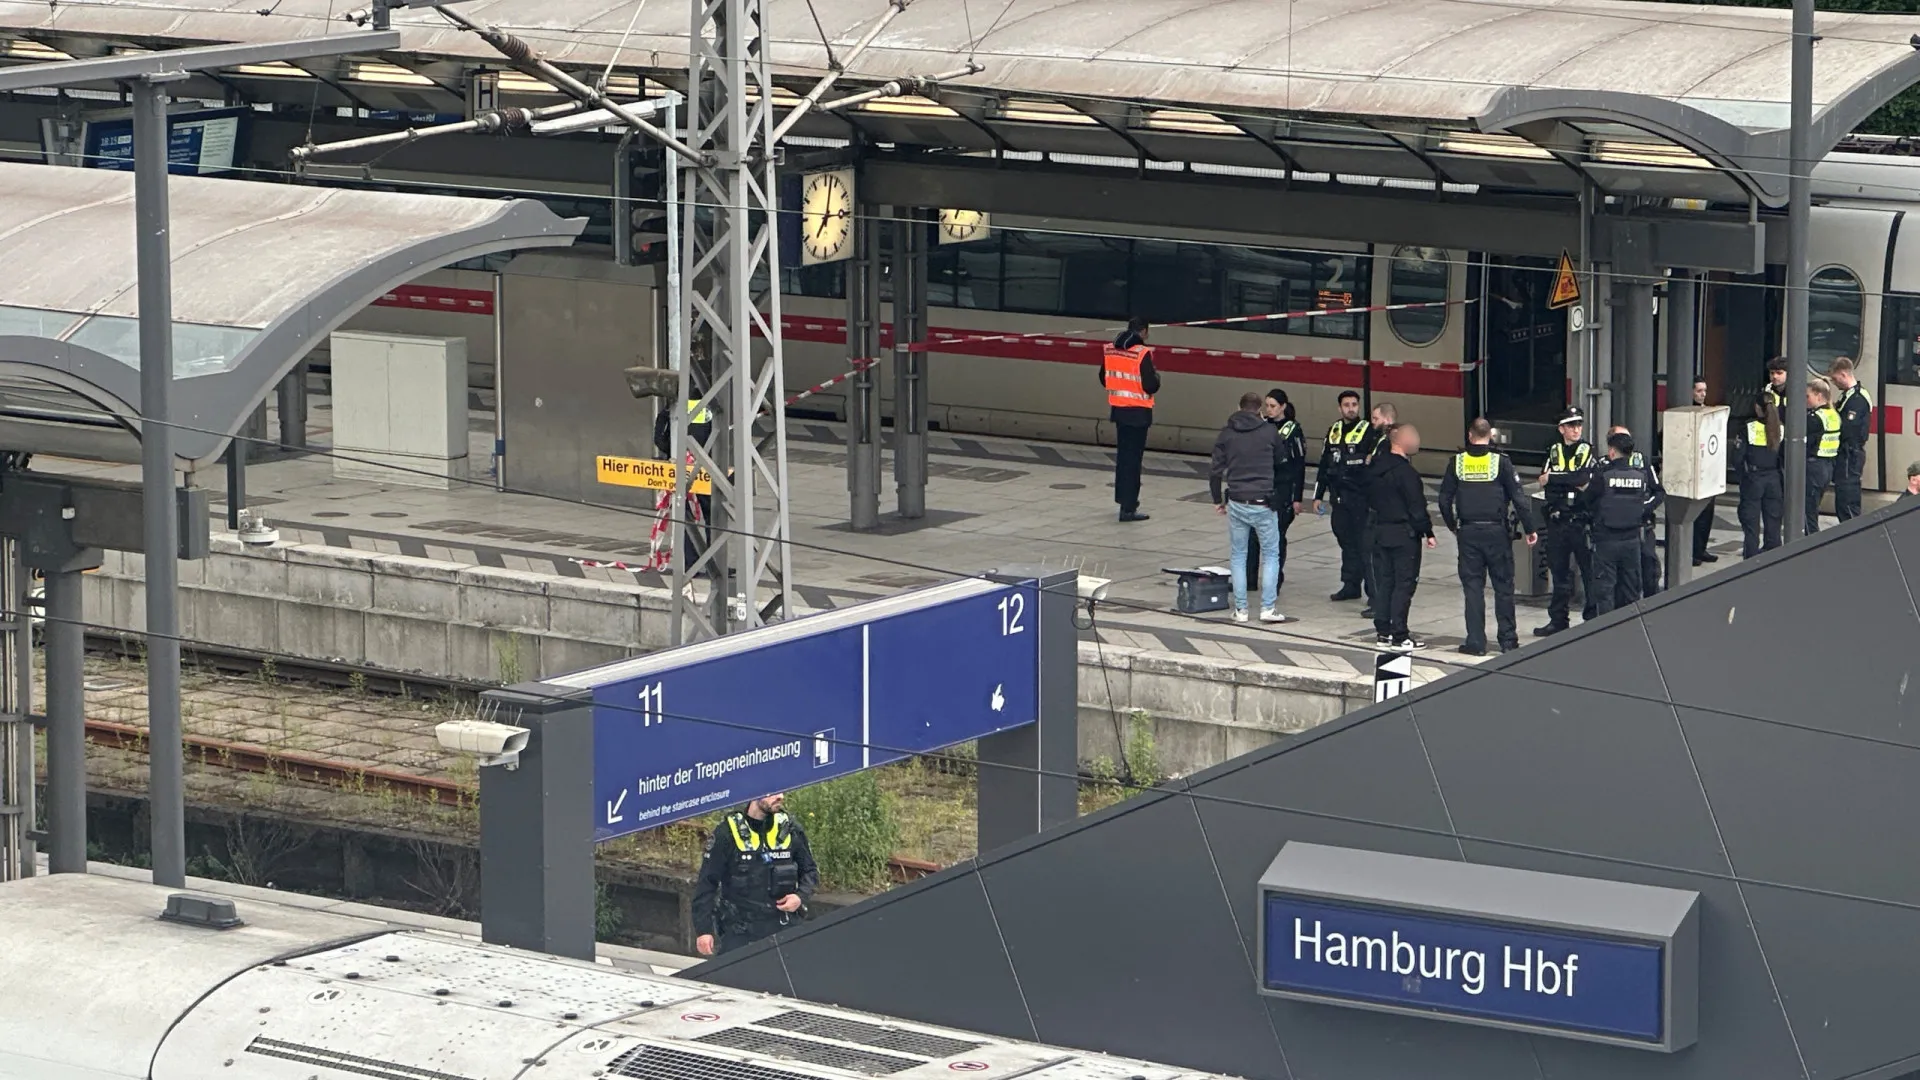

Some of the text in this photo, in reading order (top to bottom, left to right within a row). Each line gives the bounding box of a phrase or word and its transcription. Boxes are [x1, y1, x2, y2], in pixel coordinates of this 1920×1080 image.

[1323, 258, 1344, 289] 2
[603, 459, 629, 473] Hier
[632, 463, 664, 477] nicht
[1609, 477, 1642, 488] POLIZEI
[998, 593, 1025, 636] 12
[638, 681, 663, 727] 11
[638, 740, 801, 795] hinter der Treppeneinhausung
[638, 788, 730, 821] behind the staircase enclosure
[769, 851, 791, 859] POLIZEI
[1294, 917, 1579, 997] Hamburg Hbf
